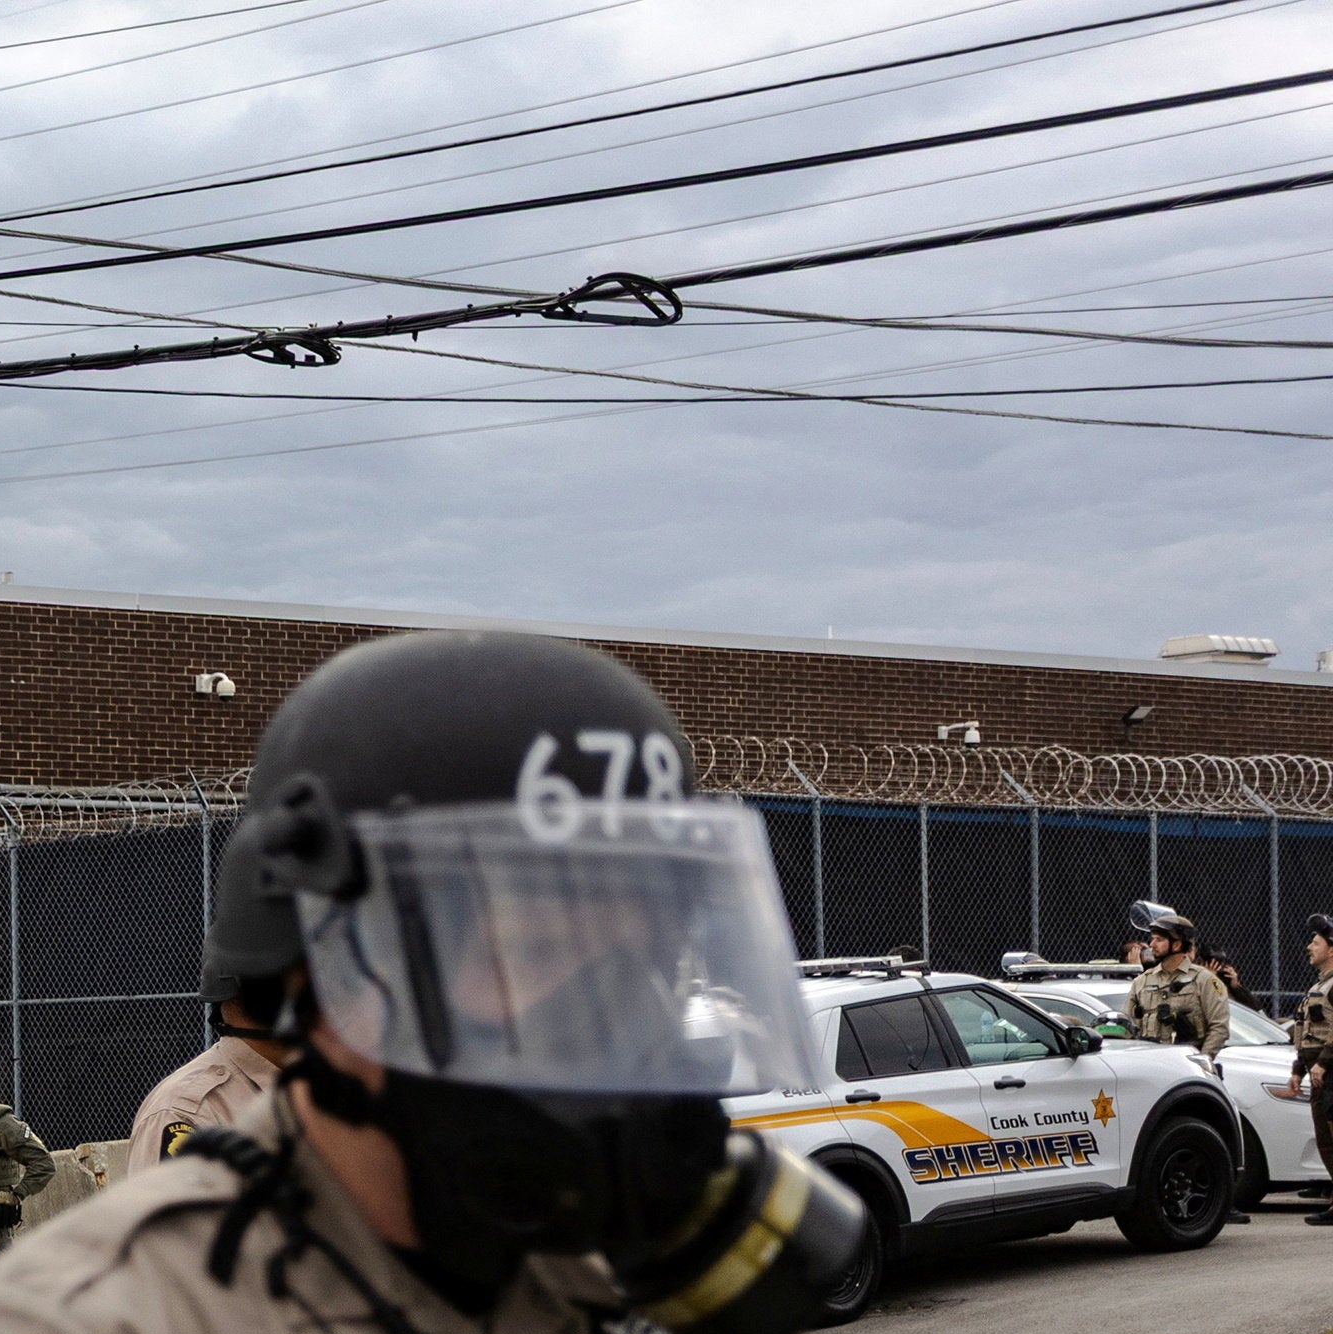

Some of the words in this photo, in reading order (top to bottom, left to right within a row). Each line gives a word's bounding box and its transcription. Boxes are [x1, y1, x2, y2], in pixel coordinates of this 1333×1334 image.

[517, 729, 681, 844] 678
[990, 1114, 1029, 1130] Cook
[1034, 1110, 1089, 1126] County
[902, 1130, 1099, 1184] SHERIFF
